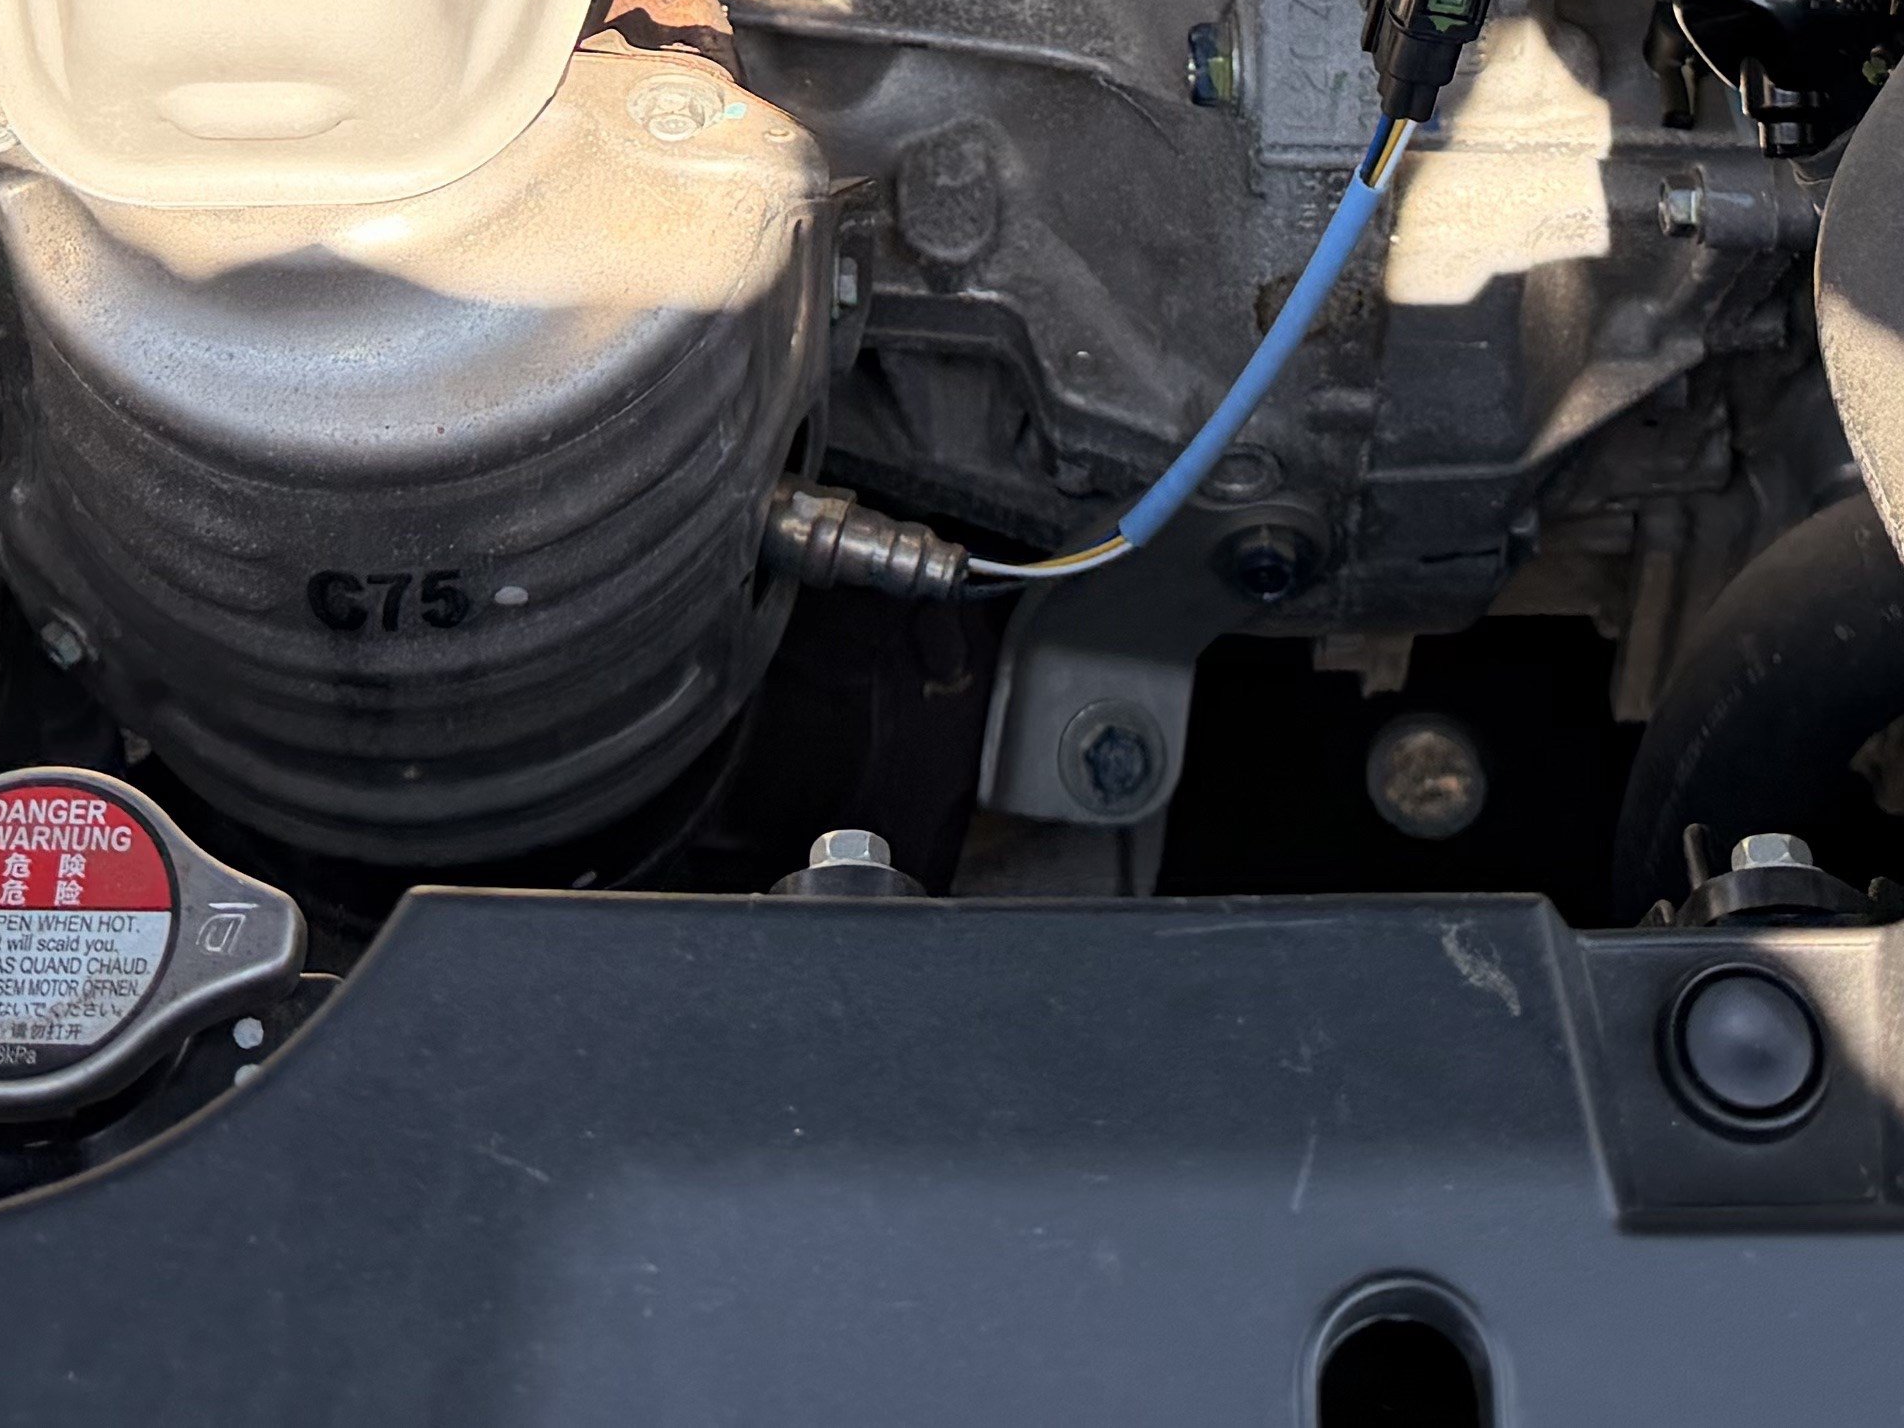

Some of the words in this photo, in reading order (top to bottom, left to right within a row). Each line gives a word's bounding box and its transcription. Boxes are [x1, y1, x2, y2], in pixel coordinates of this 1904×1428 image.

[307, 569, 471, 631] C75
[37, 915, 93, 933] WHEN
[97, 916, 141, 934] HOT.
[7, 934, 33, 952] will
[37, 935, 80, 952] scald
[83, 938, 119, 957] you.
[20, 956, 82, 975] QUAND
[87, 957, 151, 975] CHAUD.
[28, 979, 79, 996] MOTOR
